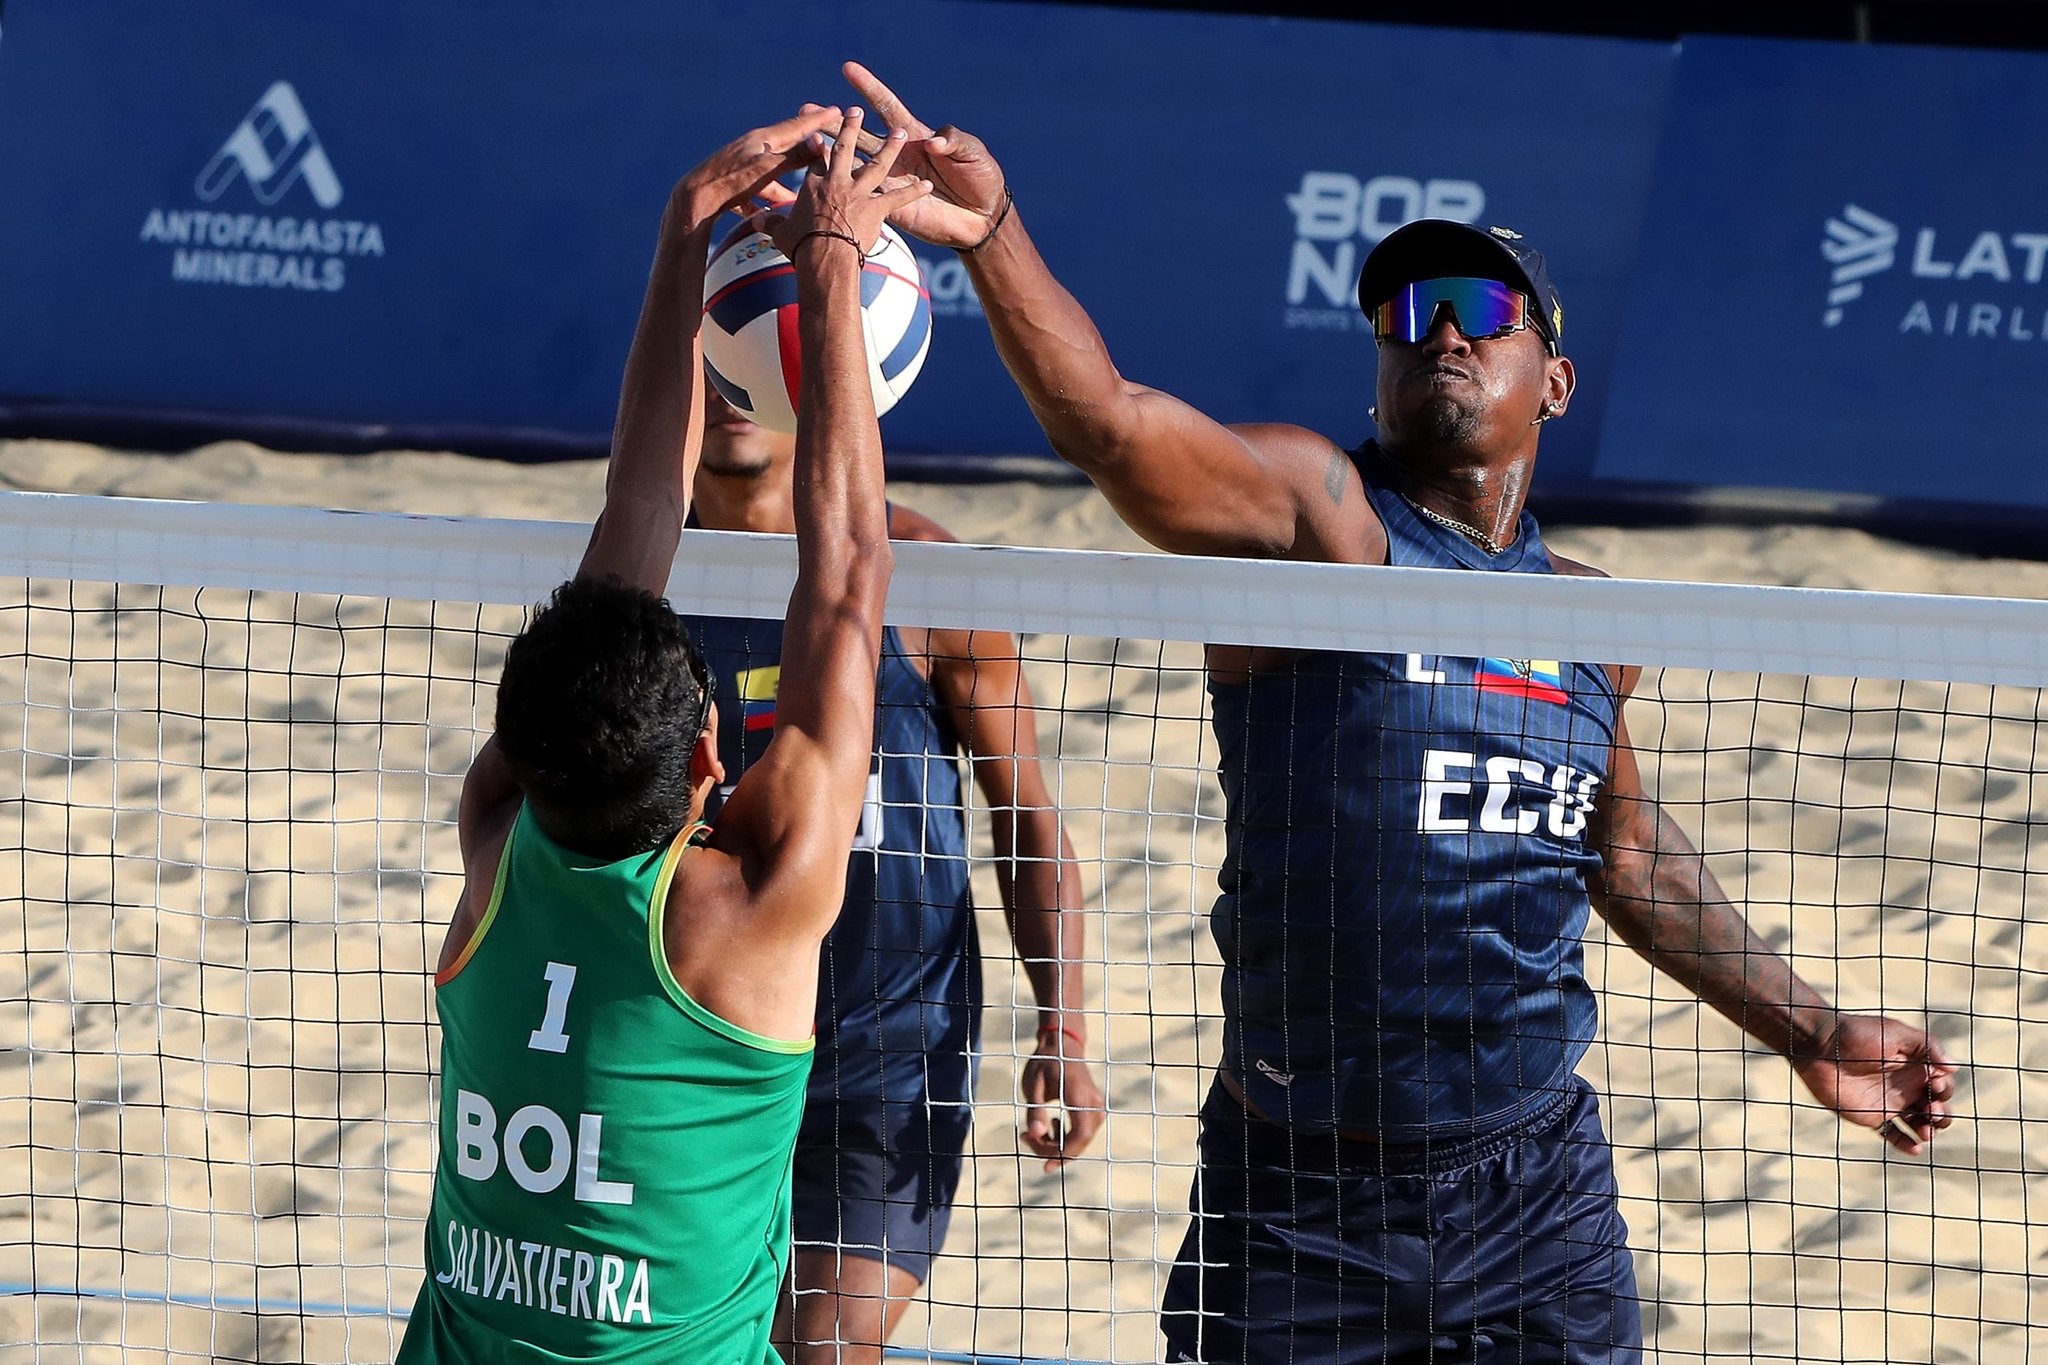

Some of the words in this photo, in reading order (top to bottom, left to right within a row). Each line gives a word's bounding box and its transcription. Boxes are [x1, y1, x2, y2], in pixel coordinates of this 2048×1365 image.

[140, 209, 385, 256] ANTOFAGASTA
[173, 250, 345, 291] MINERALS
[1417, 749, 1600, 837] ECU
[527, 961, 577, 1054] 1
[457, 1088, 634, 1205] BOL
[436, 1219, 653, 1324] SALVATIERRA
